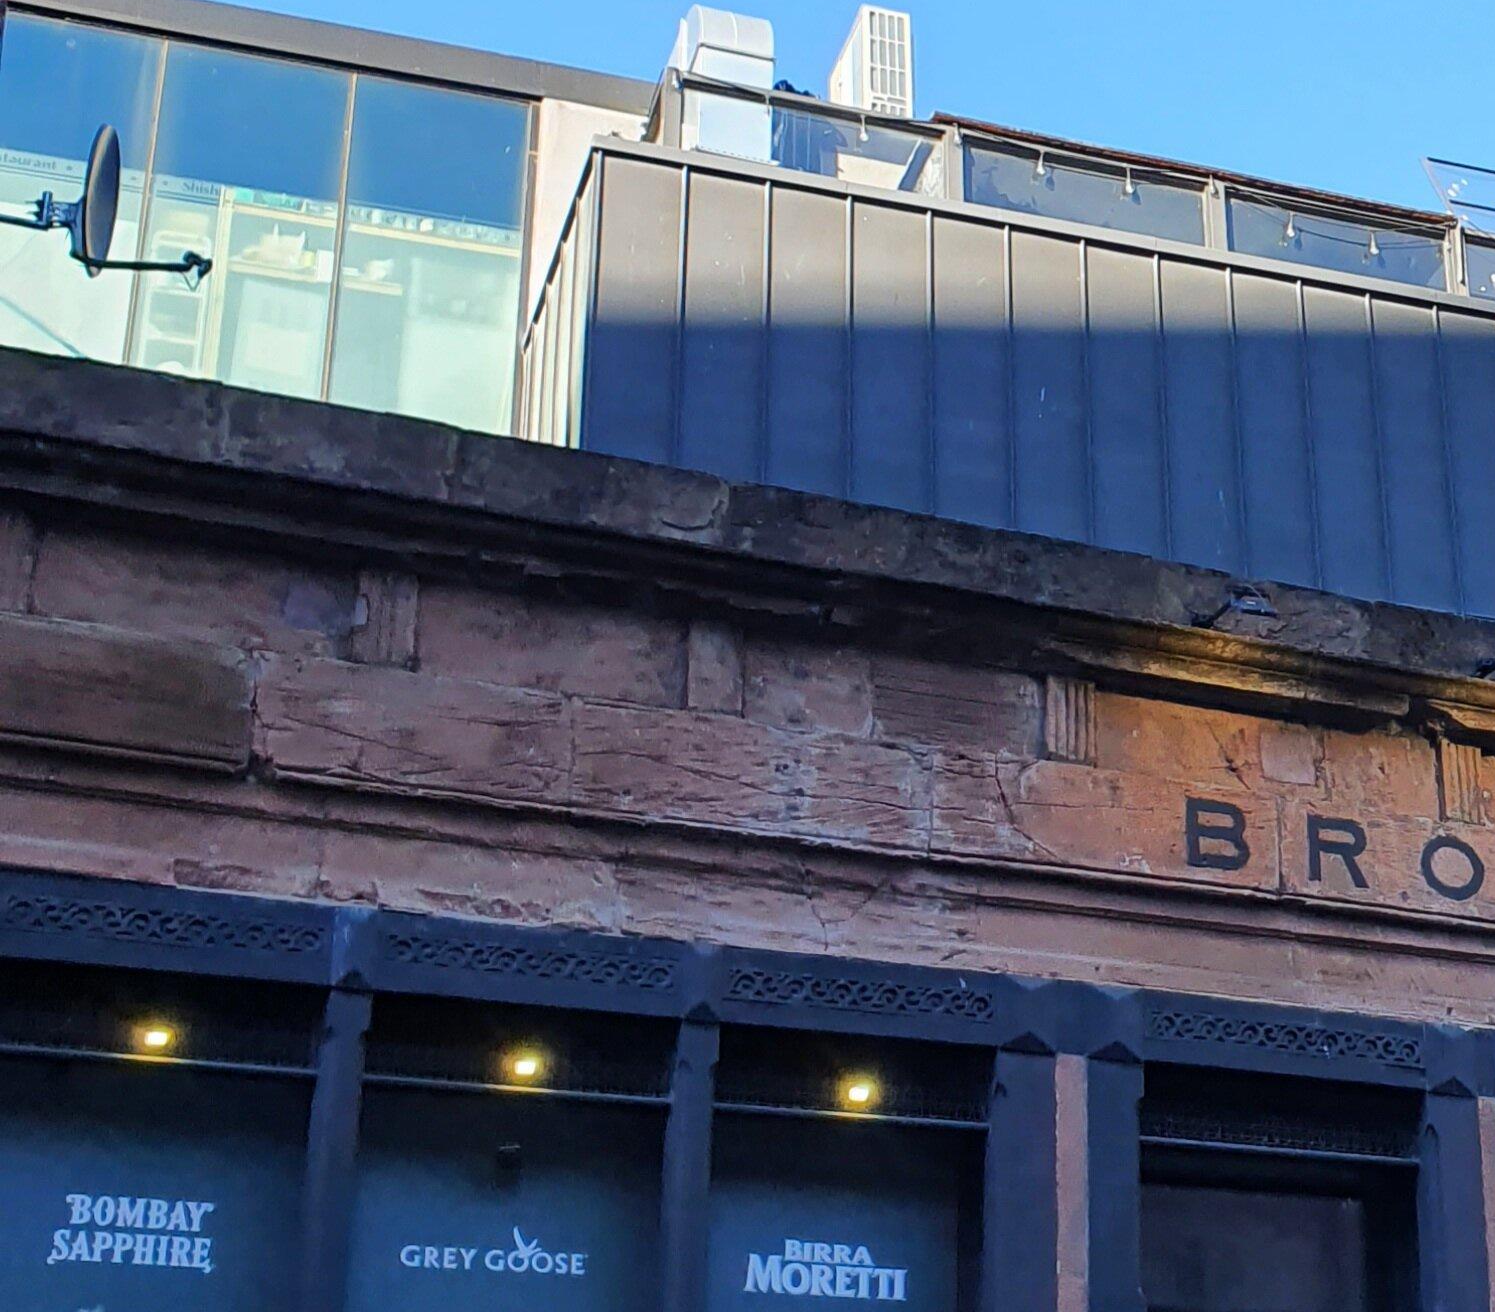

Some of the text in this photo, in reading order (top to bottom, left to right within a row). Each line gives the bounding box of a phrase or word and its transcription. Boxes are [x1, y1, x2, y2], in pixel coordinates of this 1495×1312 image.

[66, 1194, 214, 1232] BOMBAY
[47, 1229, 212, 1273] SAPPHIRE
[400, 1245, 587, 1275] GREY GOOSE
[785, 1239, 875, 1266] BIRRA
[744, 1253, 908, 1301] MORETTI
